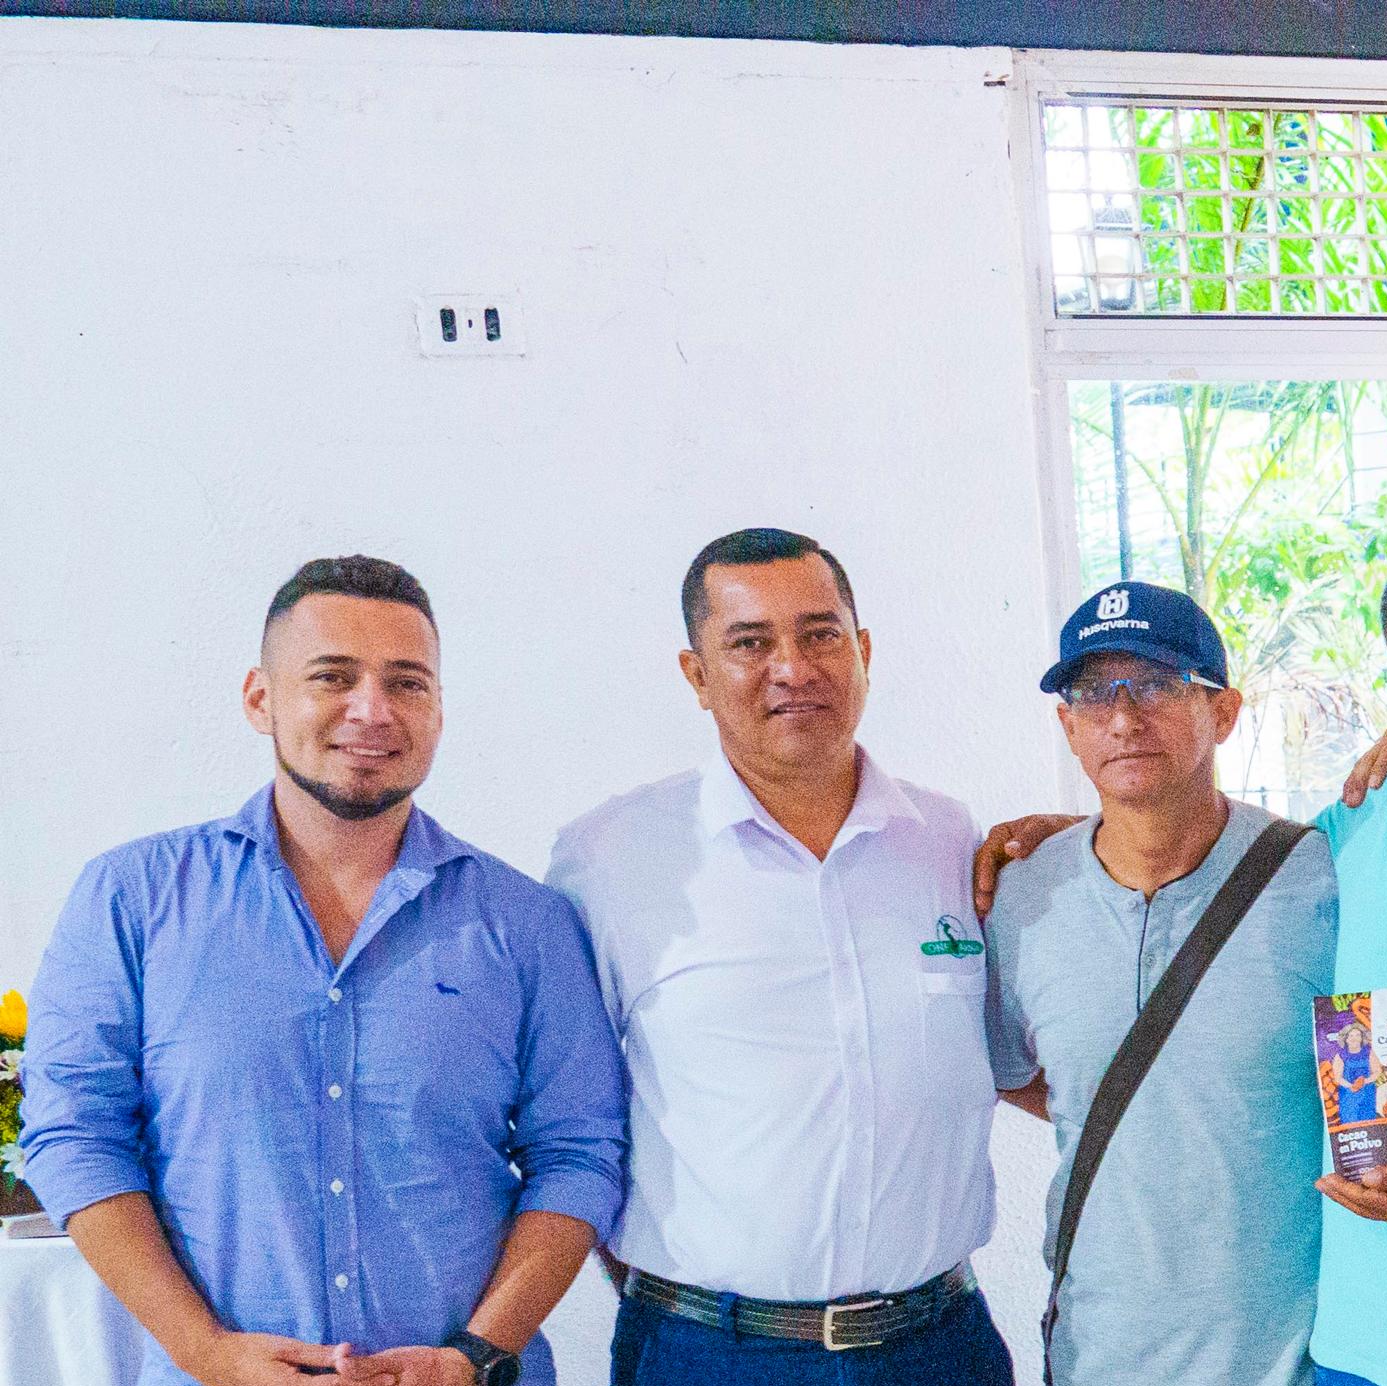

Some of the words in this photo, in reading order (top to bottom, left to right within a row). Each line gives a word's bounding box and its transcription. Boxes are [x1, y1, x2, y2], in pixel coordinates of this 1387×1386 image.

[1078, 619, 1150, 641] Husqvarna
[1338, 1130, 1368, 1143] Cacao
[1350, 1138, 1383, 1151] Polvo
